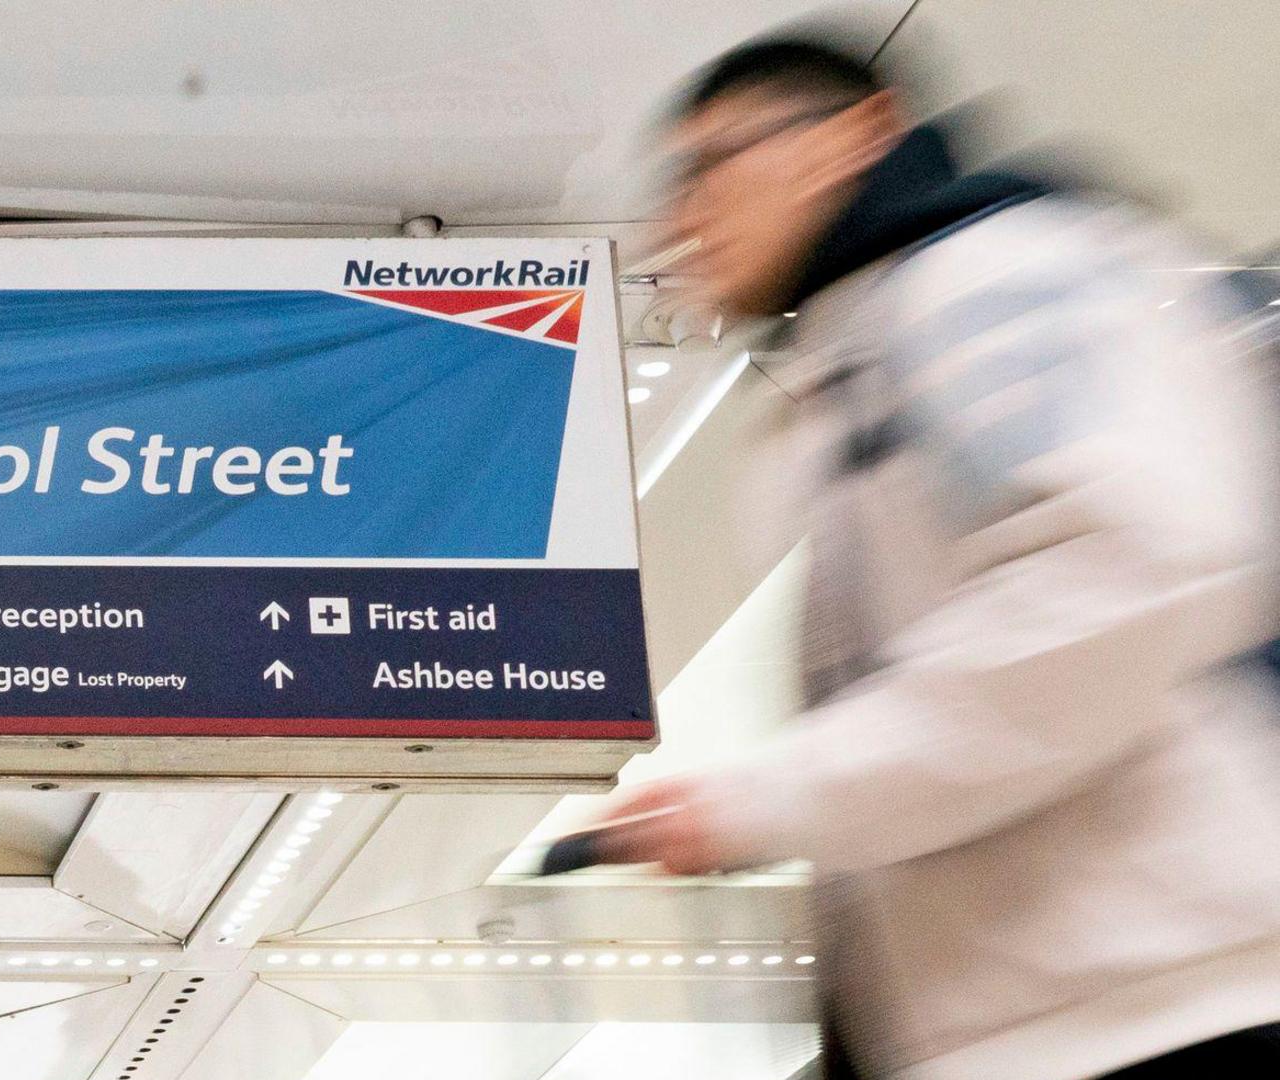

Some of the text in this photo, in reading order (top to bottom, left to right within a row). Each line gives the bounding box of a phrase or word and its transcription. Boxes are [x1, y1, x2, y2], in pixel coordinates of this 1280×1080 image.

[343, 259, 589, 287] NetworkRail
[81, 427, 355, 496] Street
[368, 603, 497, 631] First aid
[78, 672, 113, 688] Lost
[117, 673, 187, 690] Property
[373, 661, 606, 691] Ashbee House
